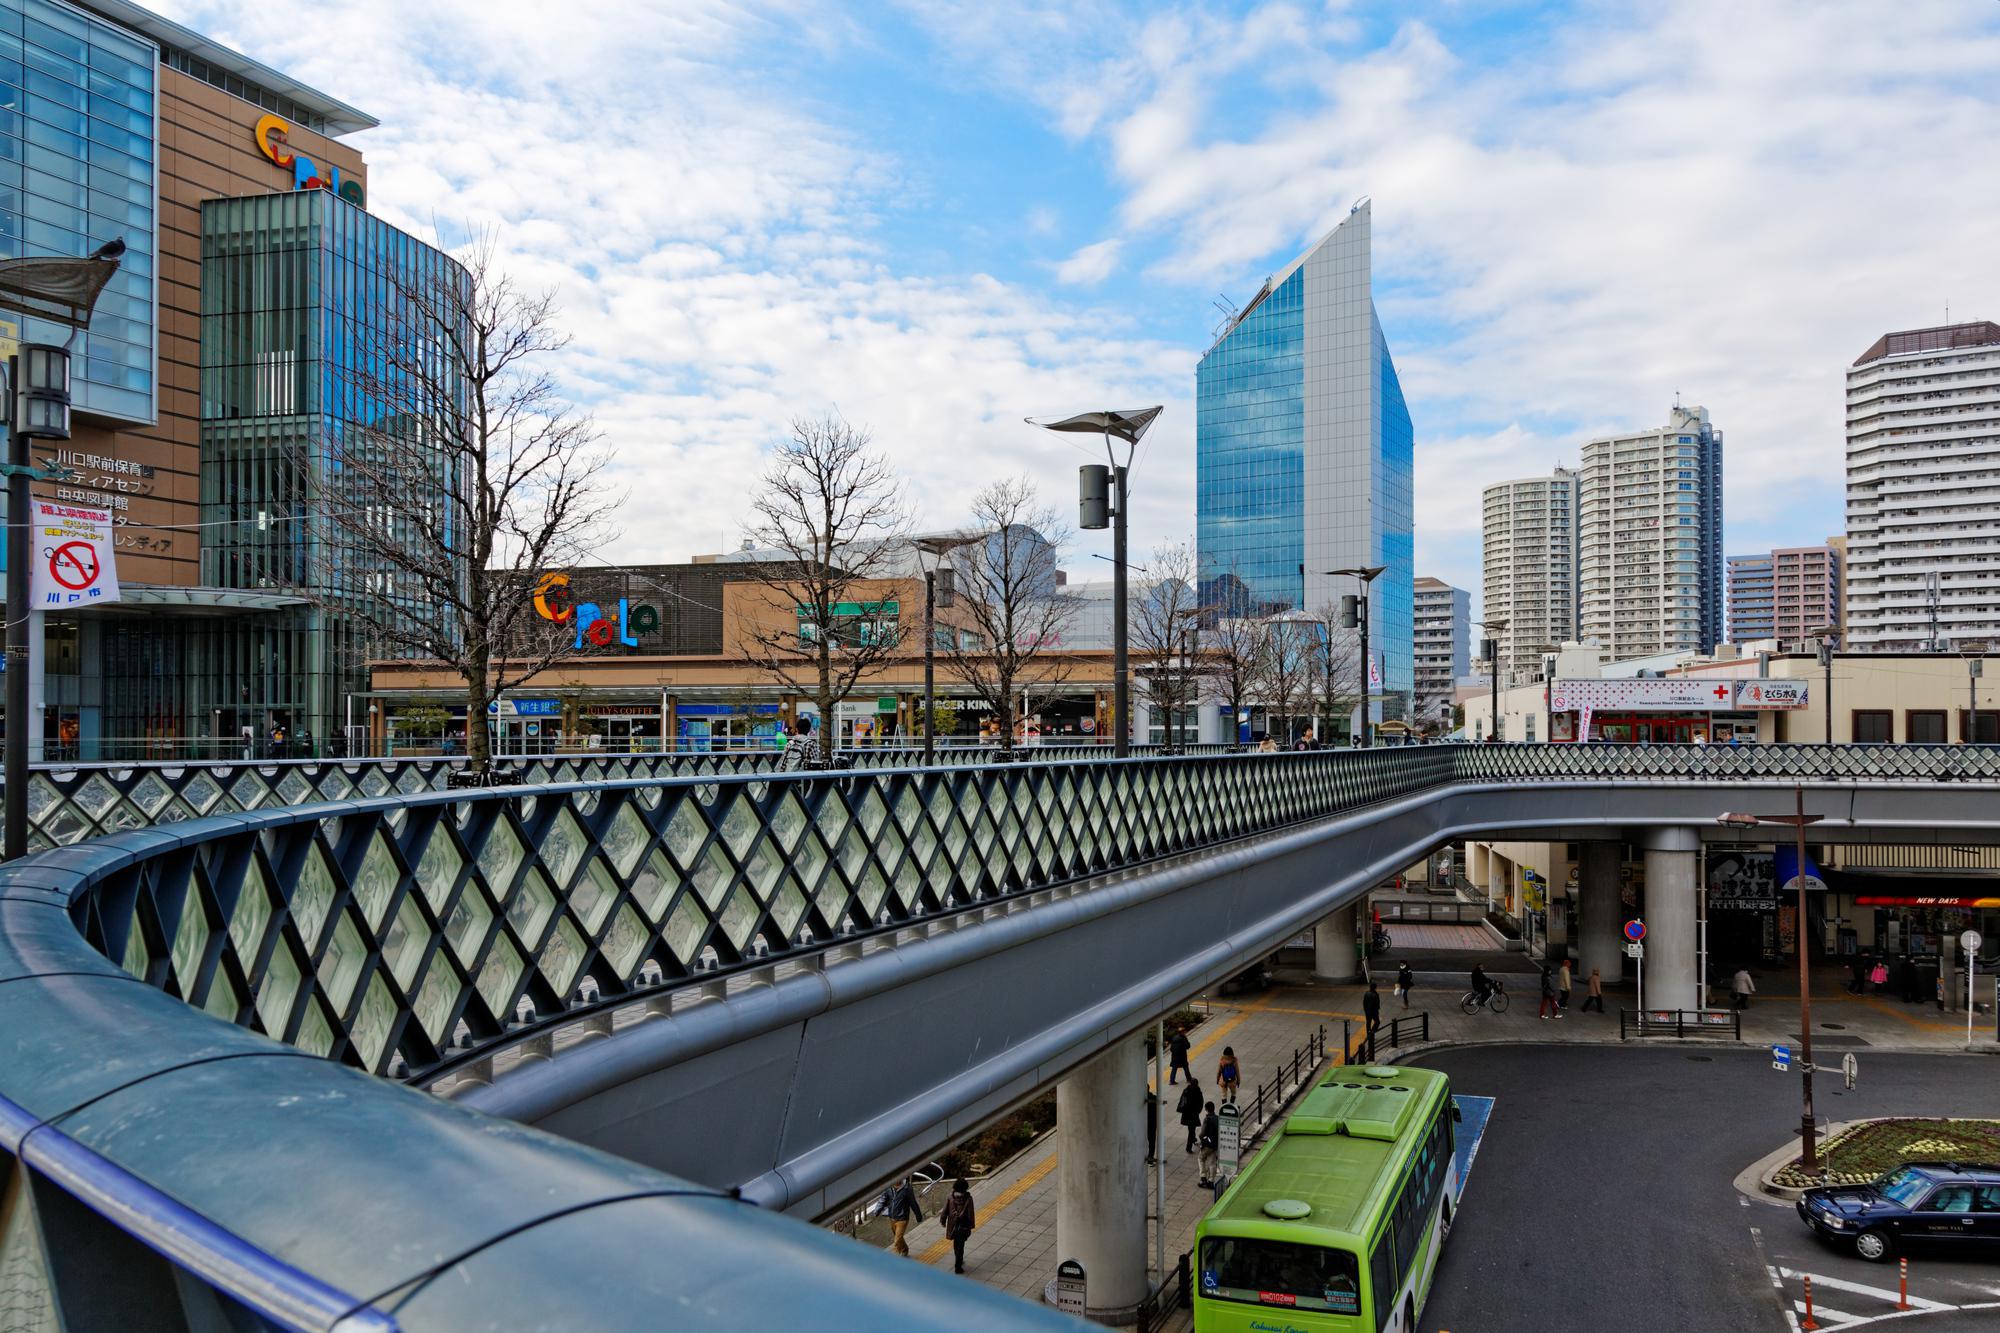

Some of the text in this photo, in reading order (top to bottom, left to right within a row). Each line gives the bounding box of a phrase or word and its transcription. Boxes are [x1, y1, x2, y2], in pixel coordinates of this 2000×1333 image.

[57, 449, 154, 479] 川口駅前保育園
[57, 488, 128, 511] 中央図書館
[47, 588, 101, 603] 川口市
[1764, 689, 1798, 698] さくら水産
[520, 702, 561, 713] 新生銀行
[620, 706, 654, 715] COFFEE
[919, 700, 996, 710] BRGER KING
[1249, 1320, 1283, 1332] Kokusai
